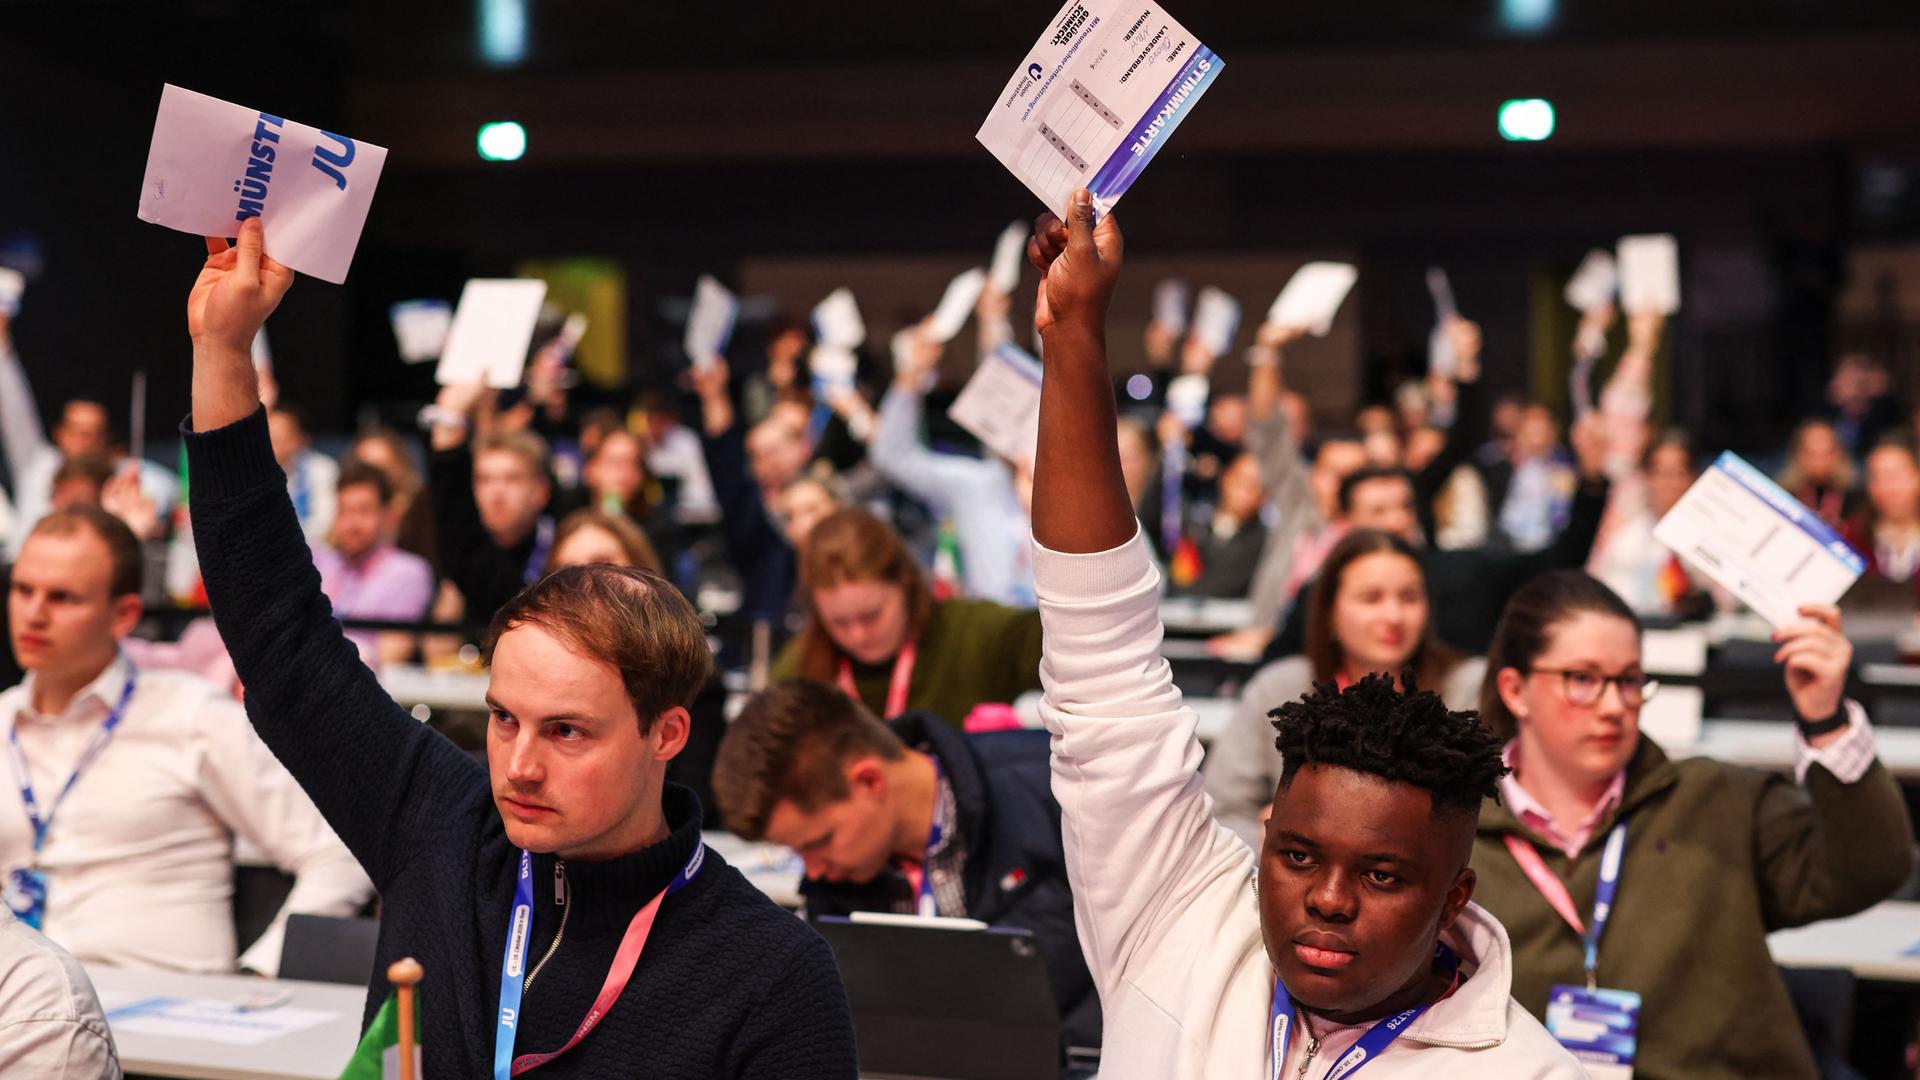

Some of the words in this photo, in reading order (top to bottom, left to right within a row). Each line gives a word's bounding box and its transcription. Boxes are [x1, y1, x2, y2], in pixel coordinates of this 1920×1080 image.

[1050, 4, 1085, 47] SCHMECKT.
[1062, 10, 1089, 46] GEFLÜGEL
[1089, 16, 1100, 29] Mit
[1122, 9, 1151, 43] NUMMER:
[1061, 27, 1092, 66] freundlicher
[1119, 25, 1168, 85] LANDESVERBAND:
[1166, 40, 1186, 64] NAME:
[1006, 76, 1029, 108] Investment
[1019, 80, 1033, 98] Union
[1028, 65, 1063, 110] Unterstützung
[1130, 58, 1213, 156] STIMMKARTE
[312, 130, 356, 191] JU
[521, 848, 529, 879] DLT2
[501, 1008, 515, 1028] JU
